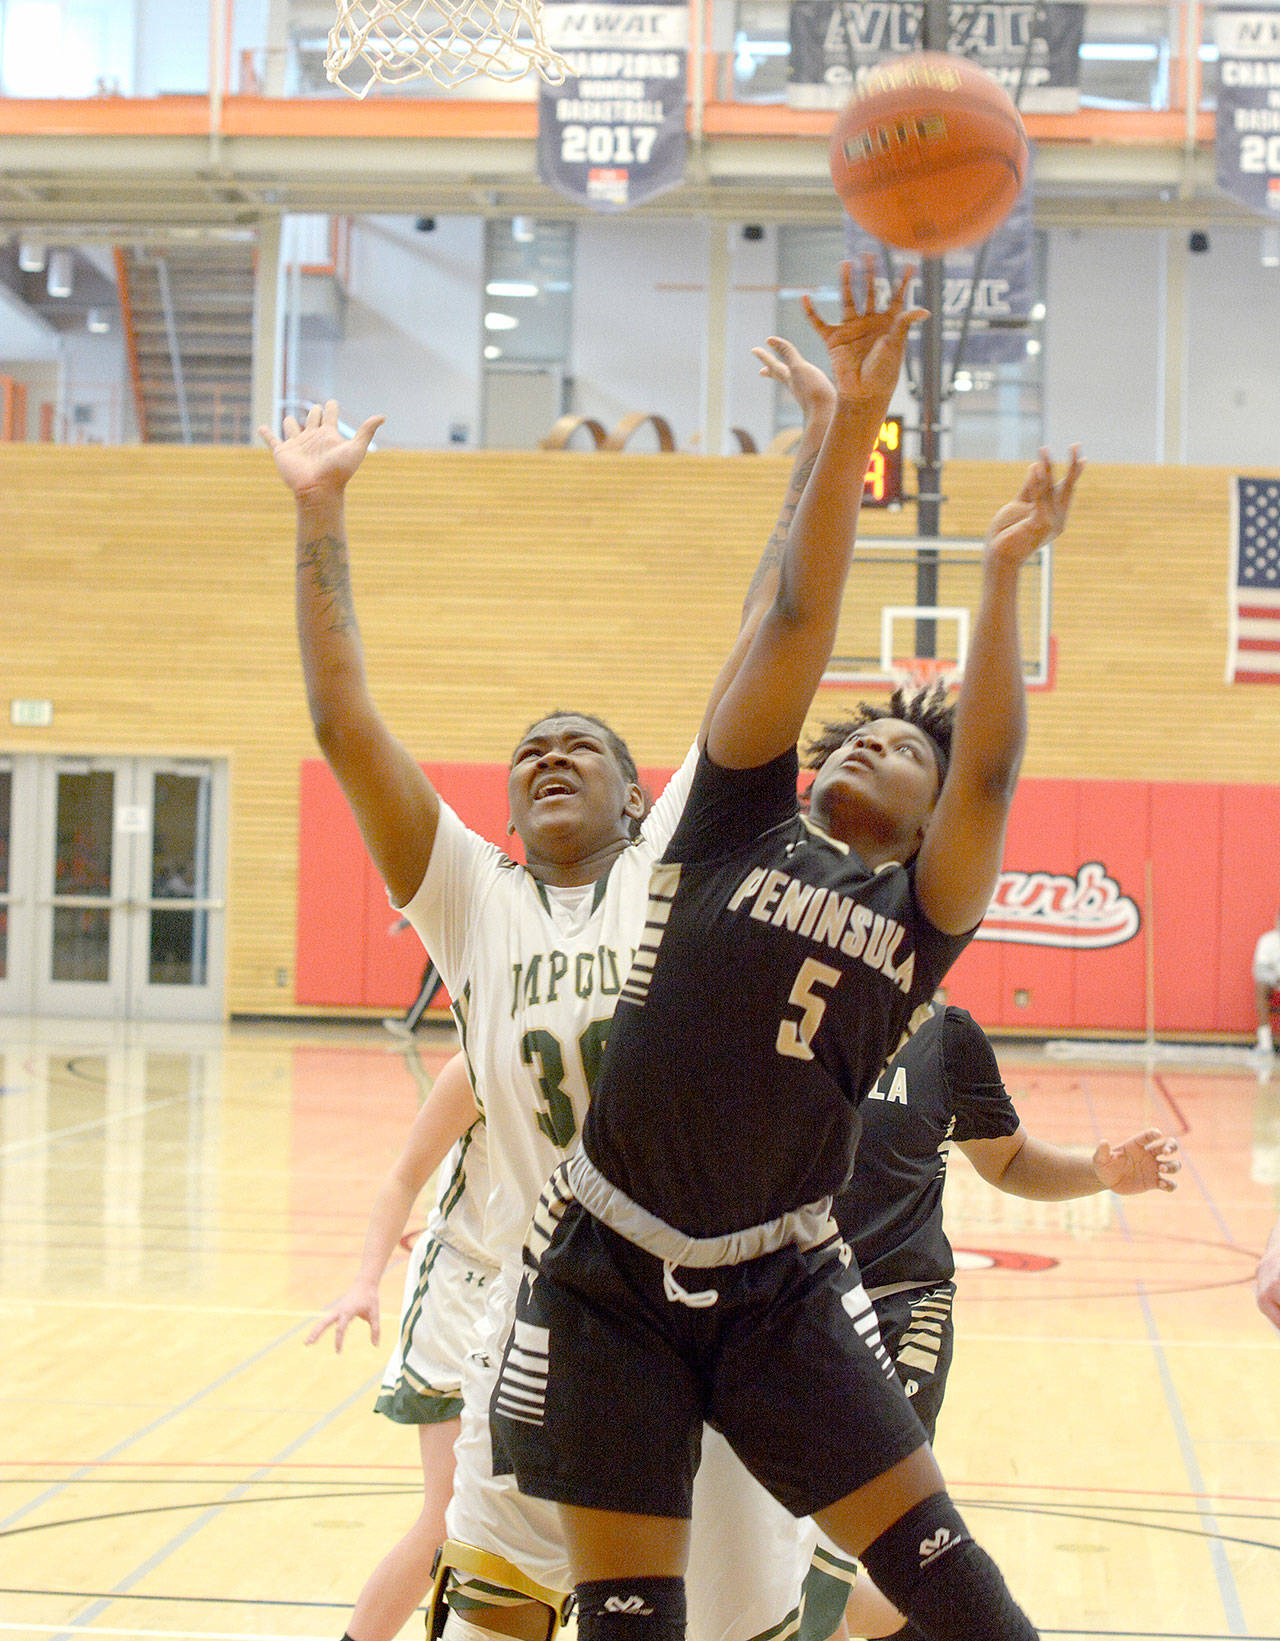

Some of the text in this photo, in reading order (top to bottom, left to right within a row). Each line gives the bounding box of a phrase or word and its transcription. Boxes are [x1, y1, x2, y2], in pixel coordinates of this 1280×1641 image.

[562, 14, 667, 34] NWAC
[561, 125, 657, 163] 2017
[727, 866, 916, 994] PENINSULA
[775, 956, 843, 1061] 5
